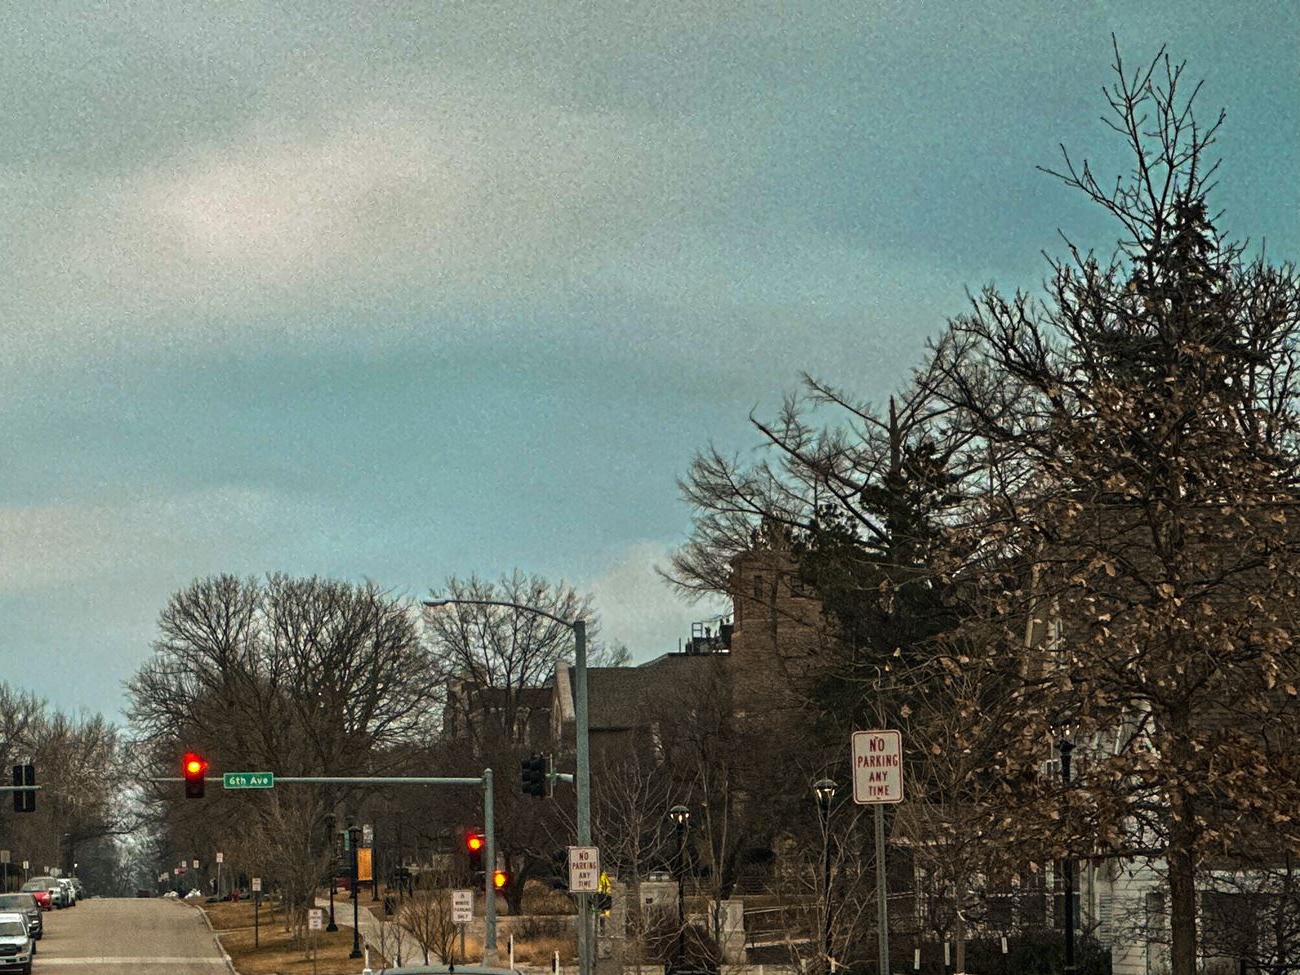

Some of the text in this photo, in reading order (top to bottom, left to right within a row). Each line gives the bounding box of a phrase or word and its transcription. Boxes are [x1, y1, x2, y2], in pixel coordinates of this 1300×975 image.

[869, 738, 885, 752] NO
[857, 754, 899, 768] PARKING
[229, 776, 268, 785] 6th Ave
[868, 771, 888, 783] ANY
[868, 785, 890, 796] TIME
[579, 852, 589, 860] NO
[572, 861, 597, 870] PARKING
[579, 871, 590, 879] ANY
[578, 880, 591, 888] TIME
